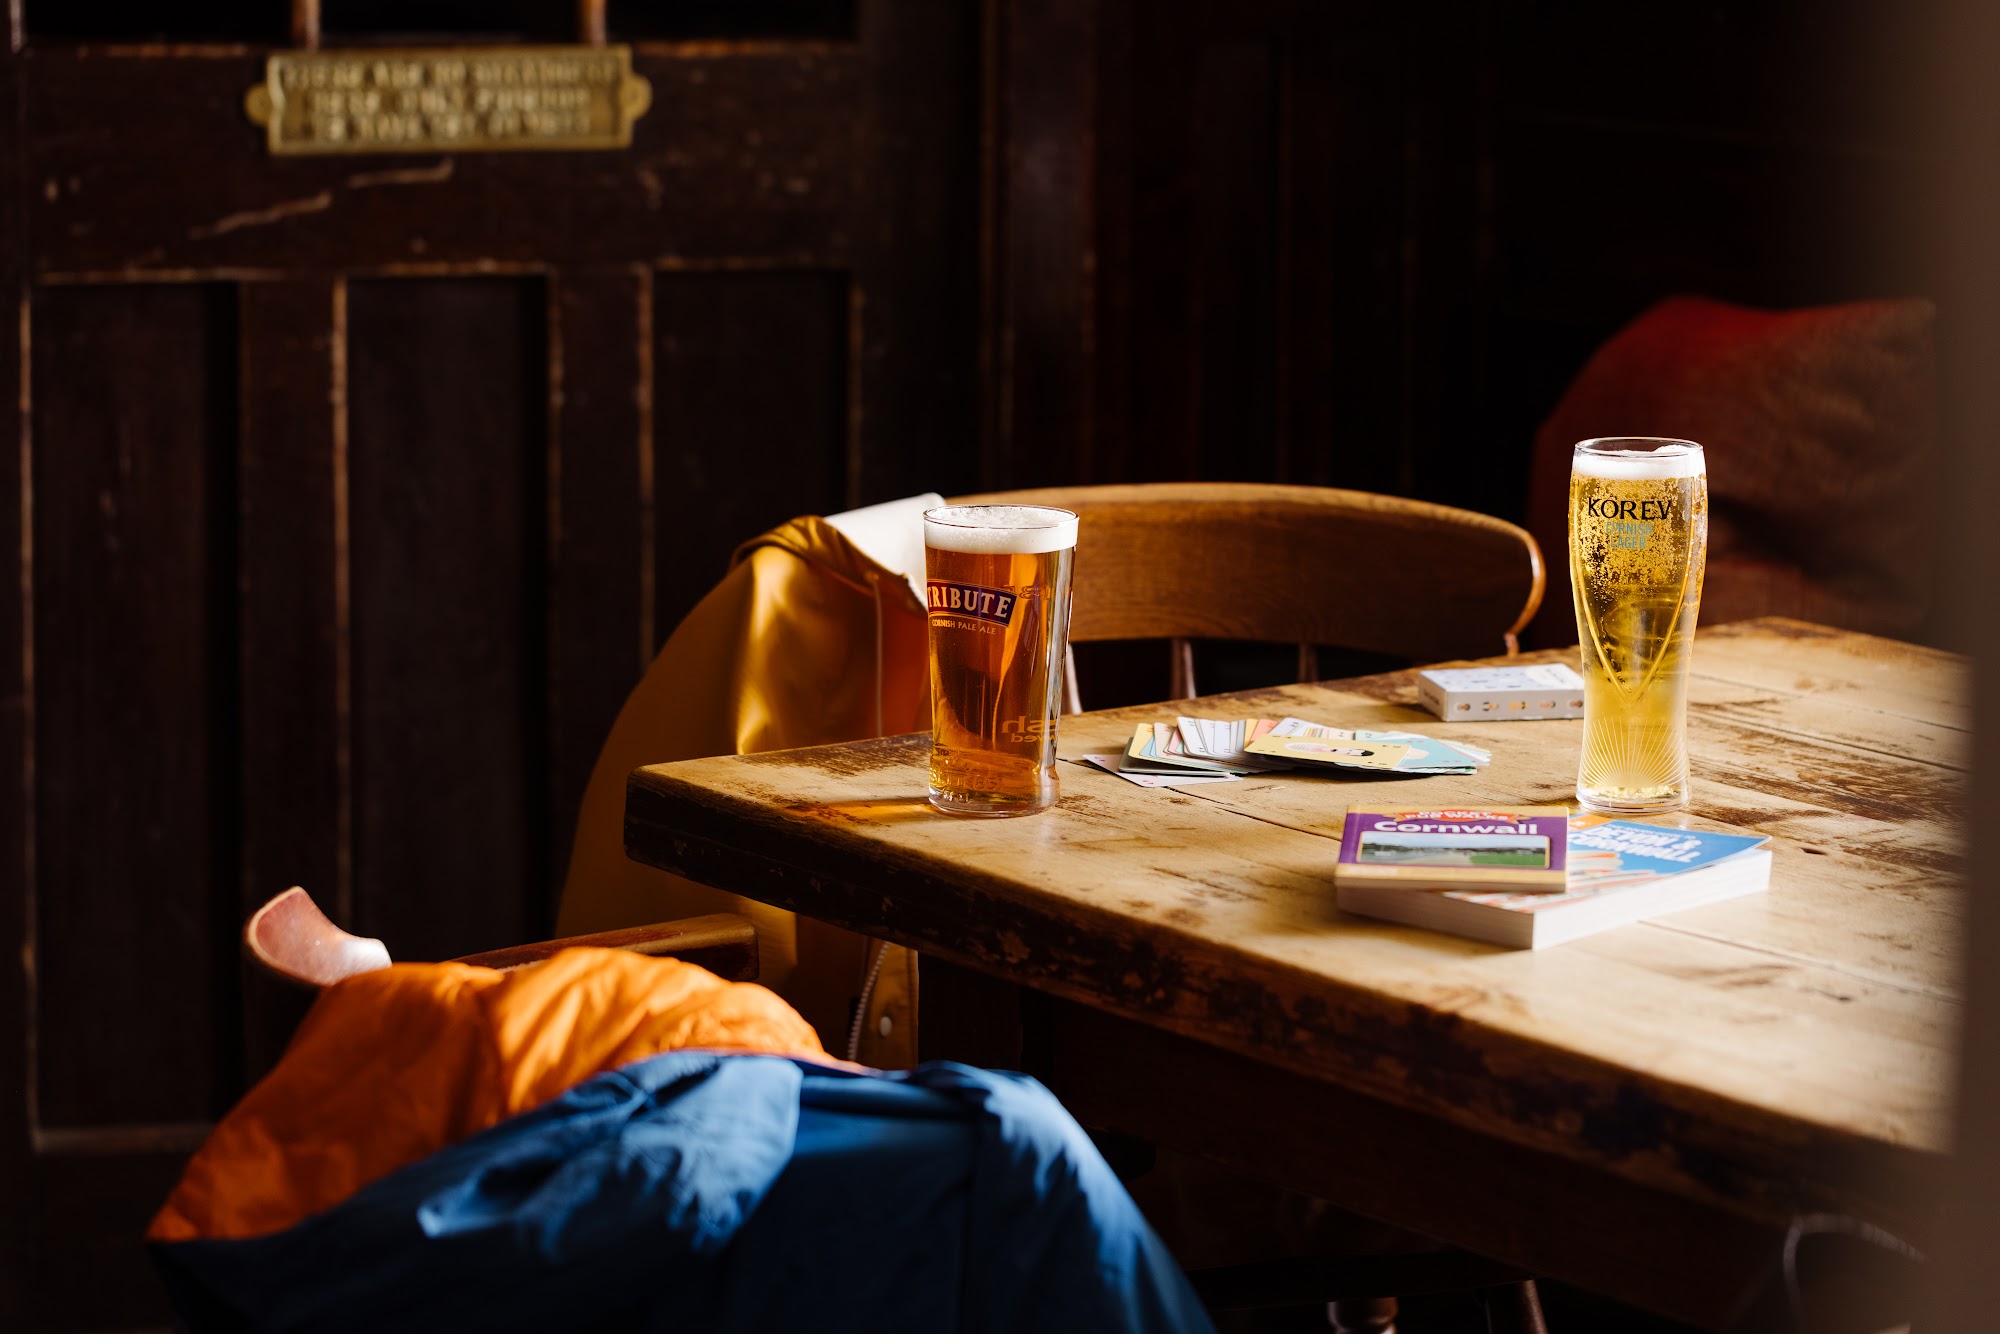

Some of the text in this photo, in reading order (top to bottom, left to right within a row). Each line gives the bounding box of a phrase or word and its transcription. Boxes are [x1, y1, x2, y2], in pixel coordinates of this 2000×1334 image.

[1606, 521, 1653, 536] CORNISH
[1611, 536, 1647, 549] LAGER
[932, 619, 996, 635] CORNISH PALE ALE
[1374, 821, 1537, 835] Cornwall
